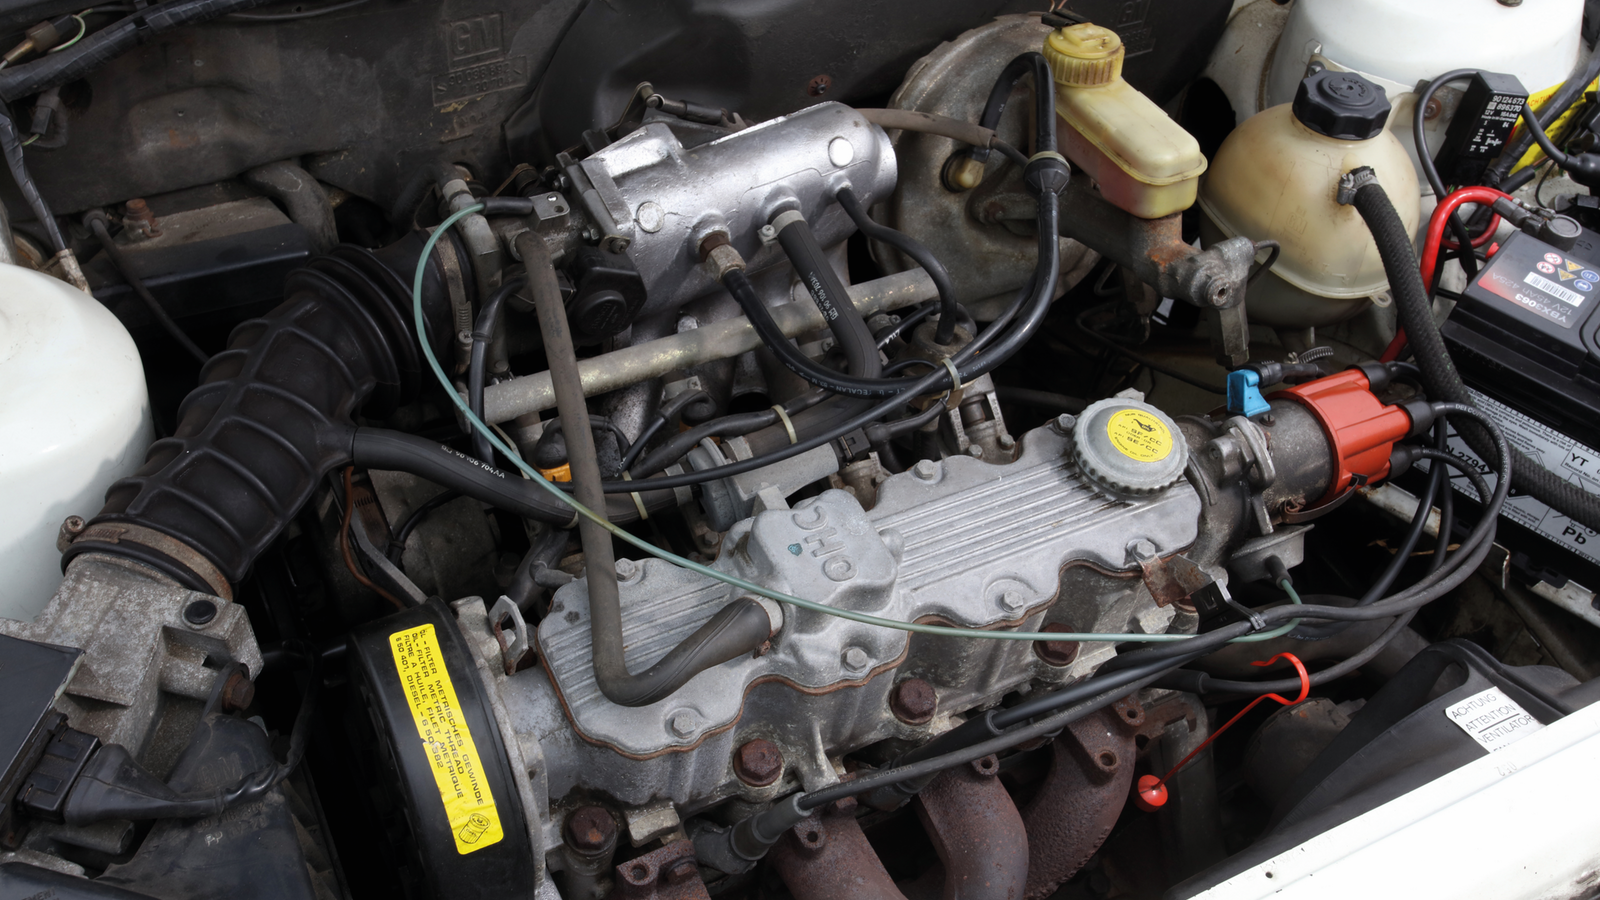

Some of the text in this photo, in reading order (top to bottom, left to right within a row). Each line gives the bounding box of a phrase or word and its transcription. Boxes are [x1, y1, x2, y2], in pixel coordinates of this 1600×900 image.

[452, 15, 500, 55] GM
[822, 300, 831, 309] 90
[1491, 273, 1572, 316] 12V 45Ah 425A
[1515, 293, 1567, 323] YBX3063
[1457, 452, 1487, 472] 2794
[1571, 453, 1589, 467] YT
[792, 505, 858, 583] OHC
[1562, 526, 1586, 544] Pb
[396, 642, 405, 653] 50
[406, 674, 422, 709] DIESEL
[401, 634, 415, 657] FILTRE
[412, 671, 429, 703] HUILE,
[426, 706, 441, 736] FILET
[438, 741, 463, 799] METRIQUE
[415, 648, 430, 677] FILTER
[427, 683, 446, 723] METRIC
[444, 728, 465, 775] THREAD
[1451, 693, 1497, 719] ACHTUNG
[1465, 704, 1516, 732] ATTENTION
[421, 718, 429, 726] 6
[423, 646, 437, 674] FILTER
[434, 679, 463, 747] METRISCHES
[461, 753, 484, 806] GEWINDE
[424, 728, 435, 743] 50
[1478, 715, 1533, 744] VENTILATOR
